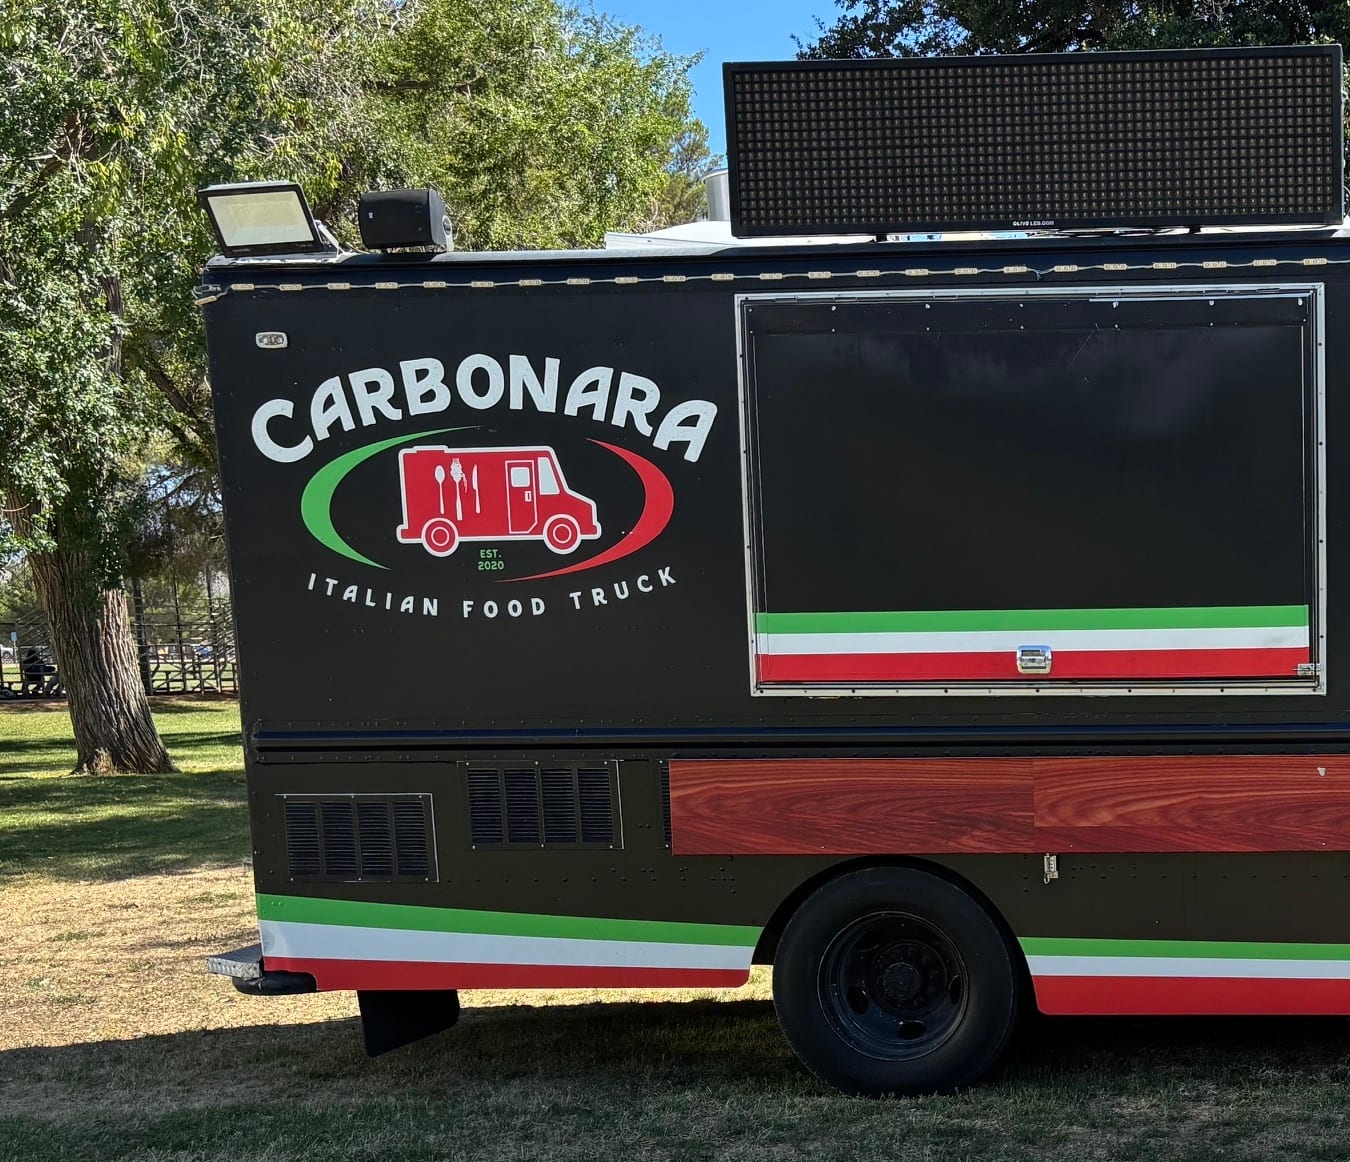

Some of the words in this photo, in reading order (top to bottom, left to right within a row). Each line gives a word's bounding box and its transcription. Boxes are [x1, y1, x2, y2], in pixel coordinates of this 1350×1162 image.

[251, 353, 718, 463] CARBONARA
[477, 560, 504, 571] 2020
[480, 549, 502, 559] EST.
[307, 572, 438, 617] ITALIAN
[463, 598, 546, 618] FOOD
[569, 566, 677, 611] TRUCK
